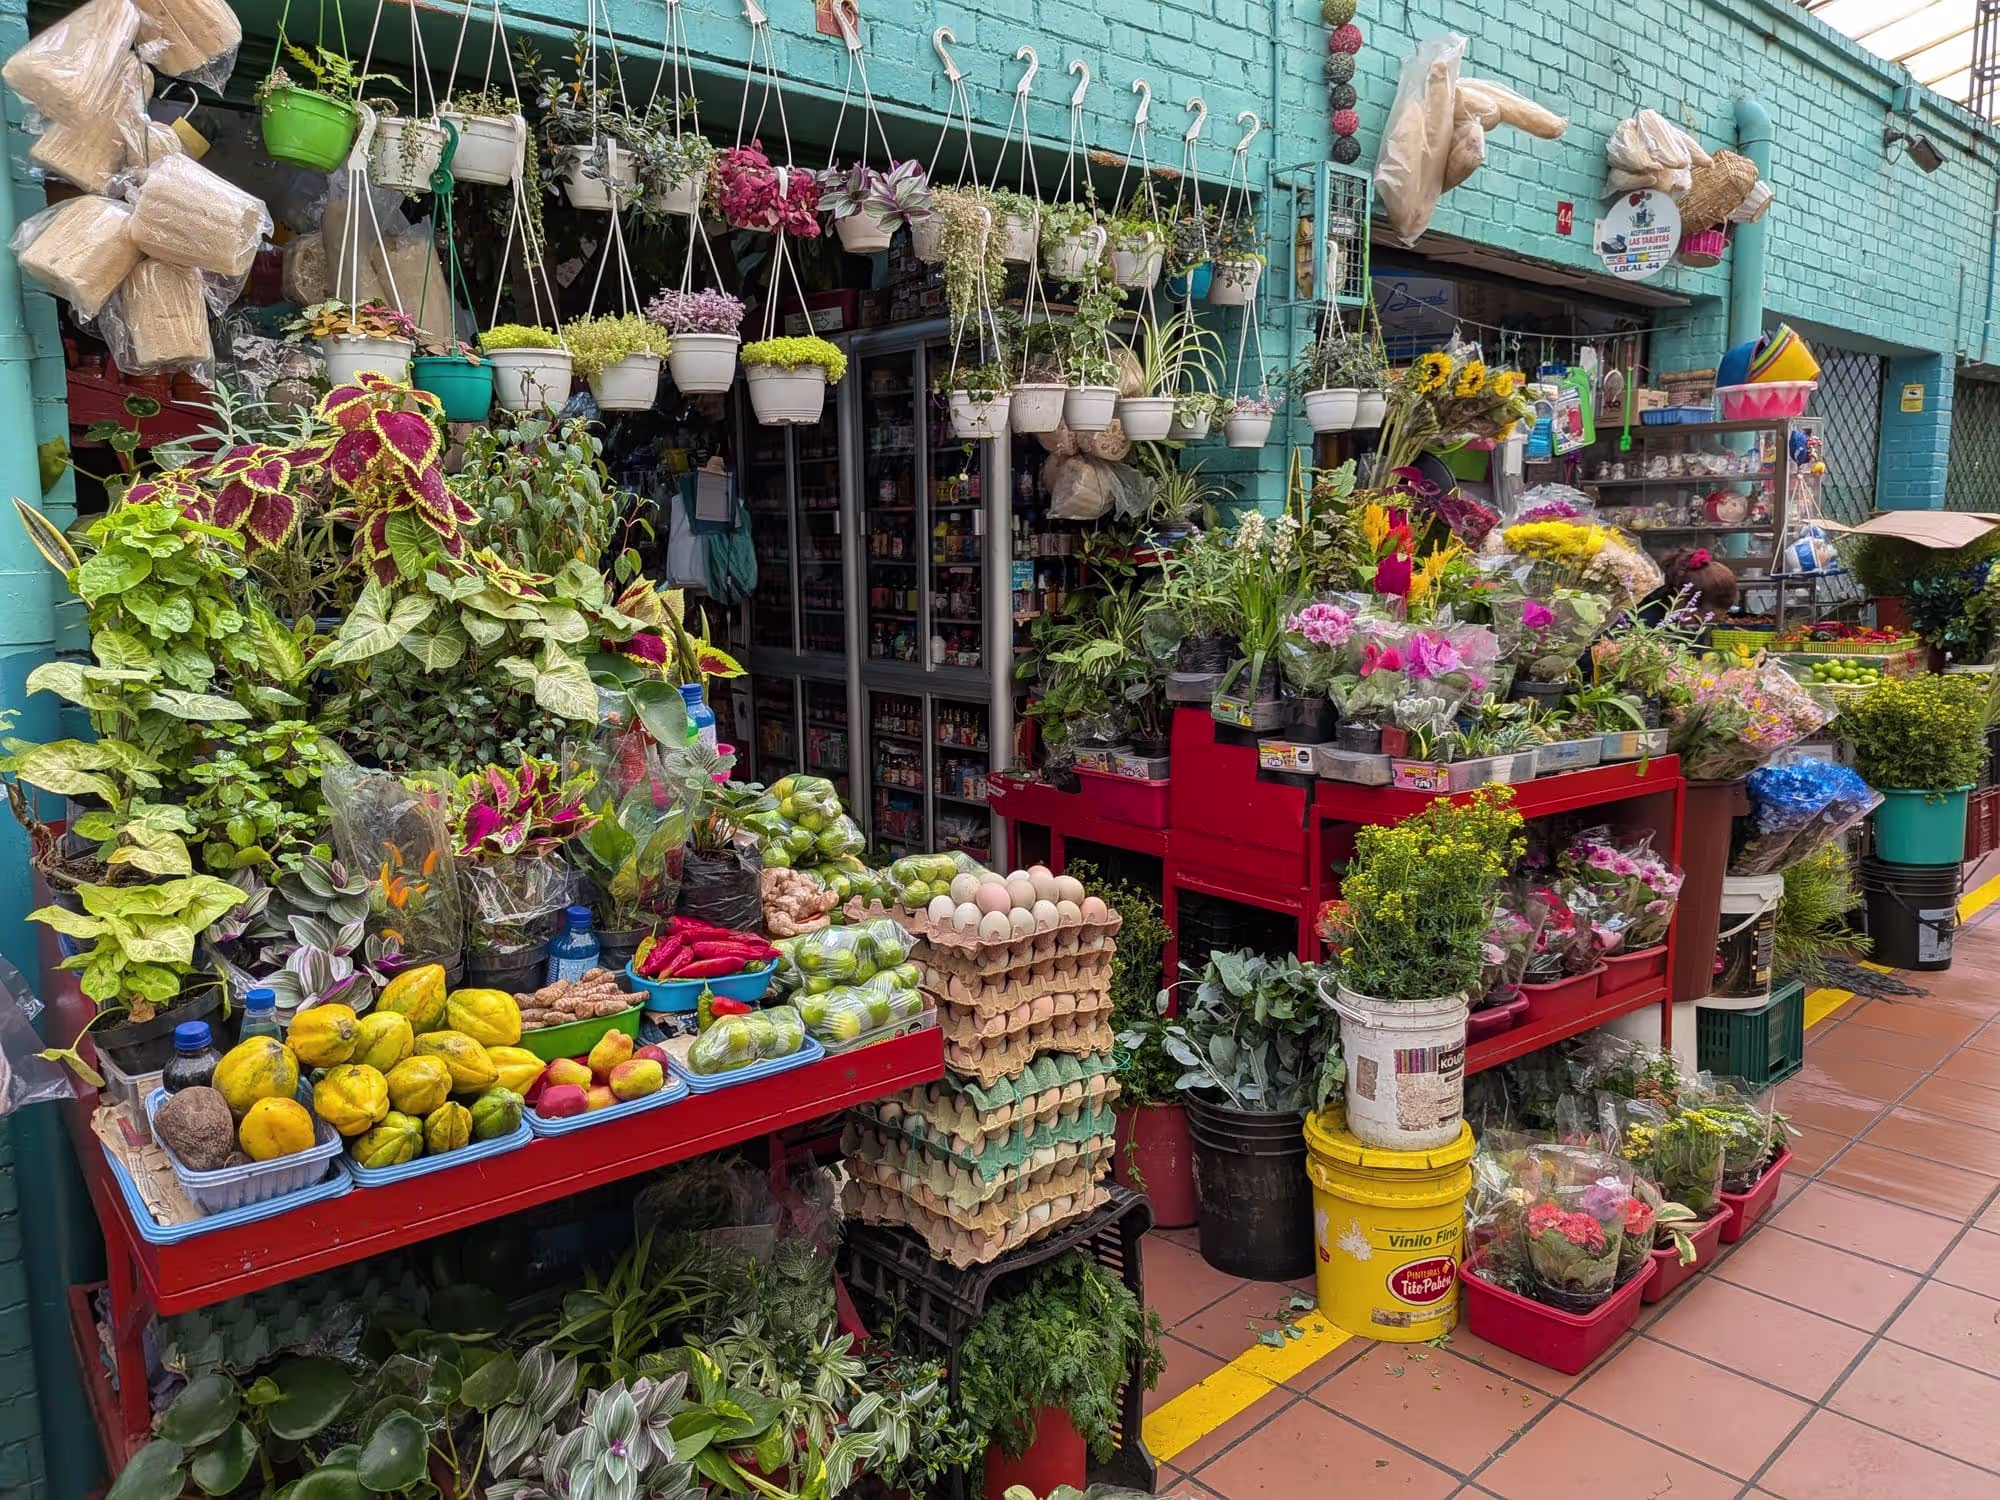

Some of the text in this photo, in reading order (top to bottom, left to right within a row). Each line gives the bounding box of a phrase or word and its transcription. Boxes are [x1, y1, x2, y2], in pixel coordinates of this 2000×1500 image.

[1558, 208, 1571, 227] 44
[1642, 235, 1669, 243] TARJETAS
[1614, 264, 1643, 272] LOCAL
[1389, 1227, 1458, 1248] Vinilo Fino
[1406, 1268, 1440, 1280] PINTURAS
